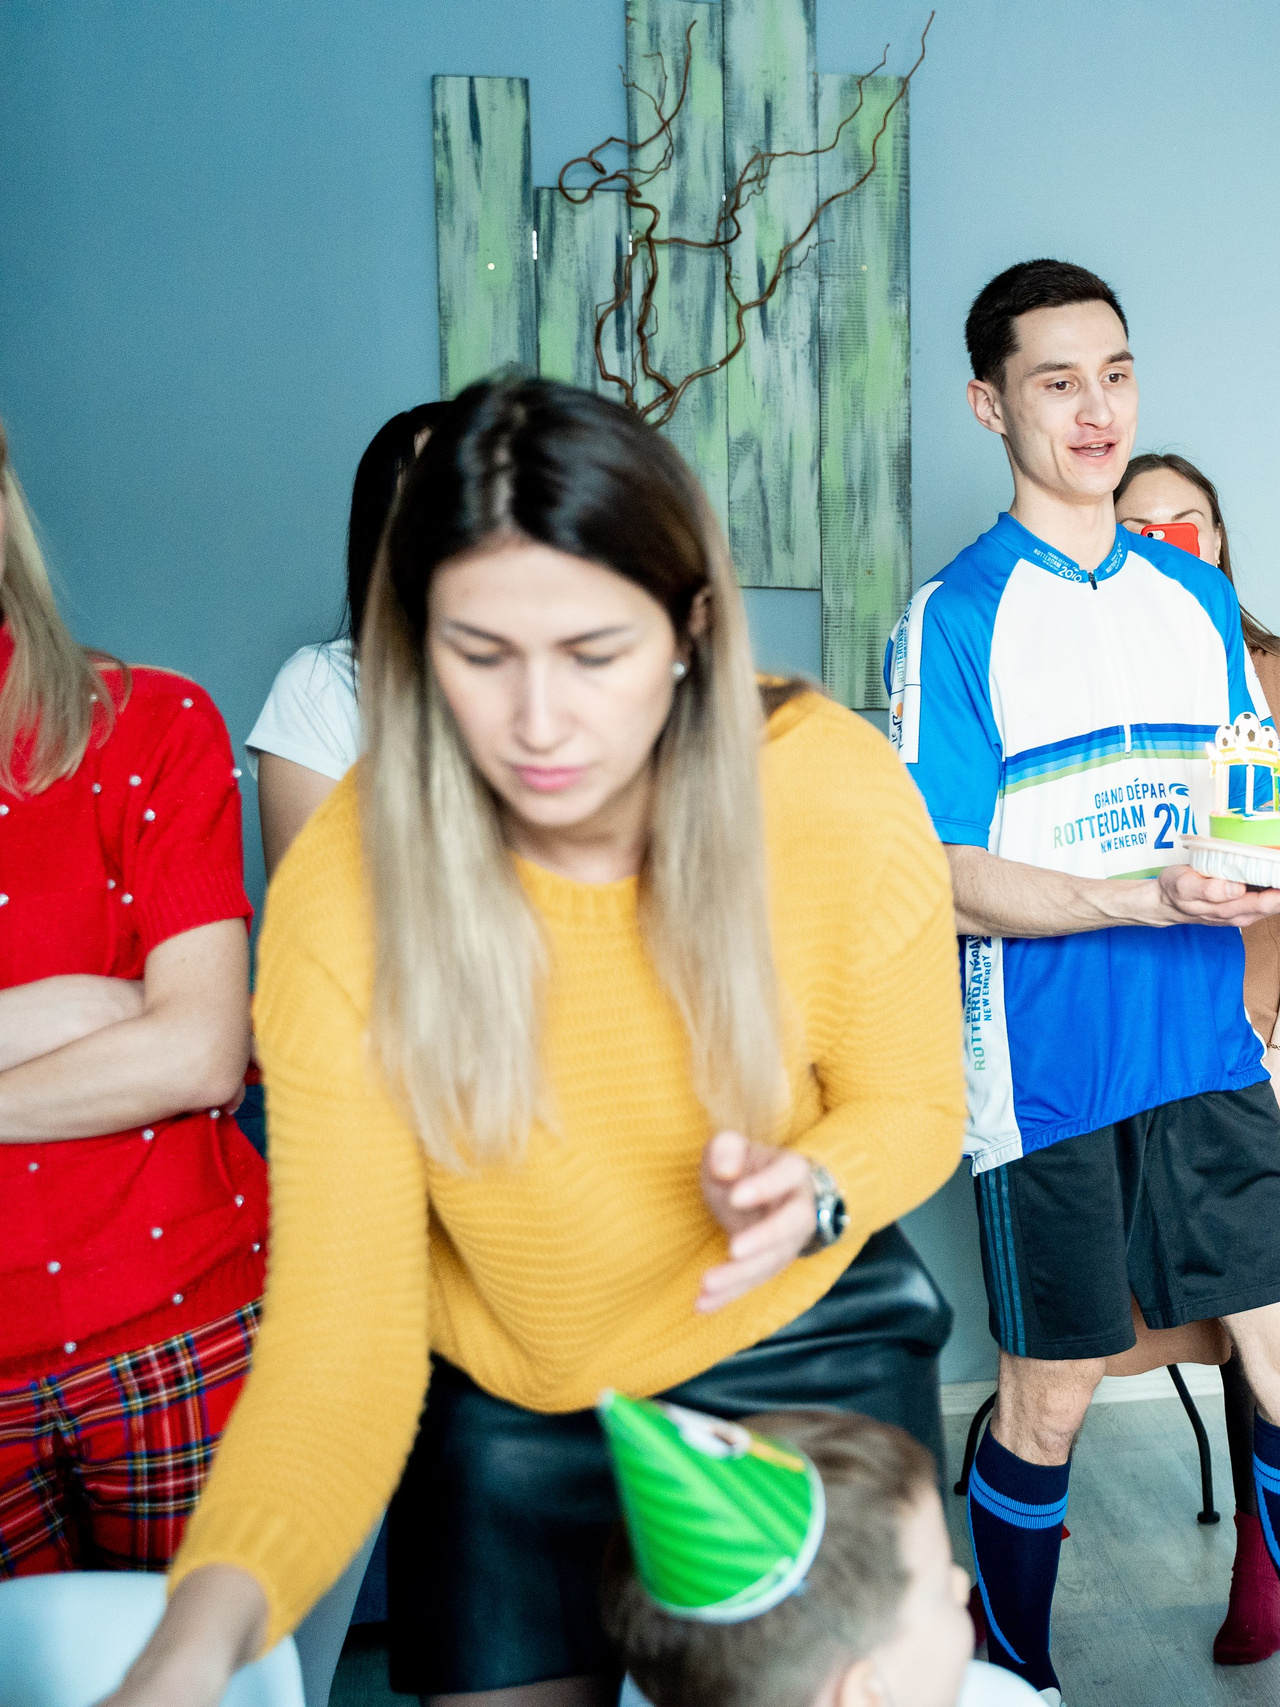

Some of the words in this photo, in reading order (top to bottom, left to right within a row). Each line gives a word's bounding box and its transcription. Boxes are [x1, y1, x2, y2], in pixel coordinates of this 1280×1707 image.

[1058, 566, 1082, 582] 2010
[1126, 777, 1167, 801] DÉPAR
[1054, 804, 1146, 849] ROTTERDAM
[1114, 832, 1148, 850] ENERGY
[982, 955, 991, 996] ENERGY
[983, 1000, 992, 1021] NEW
